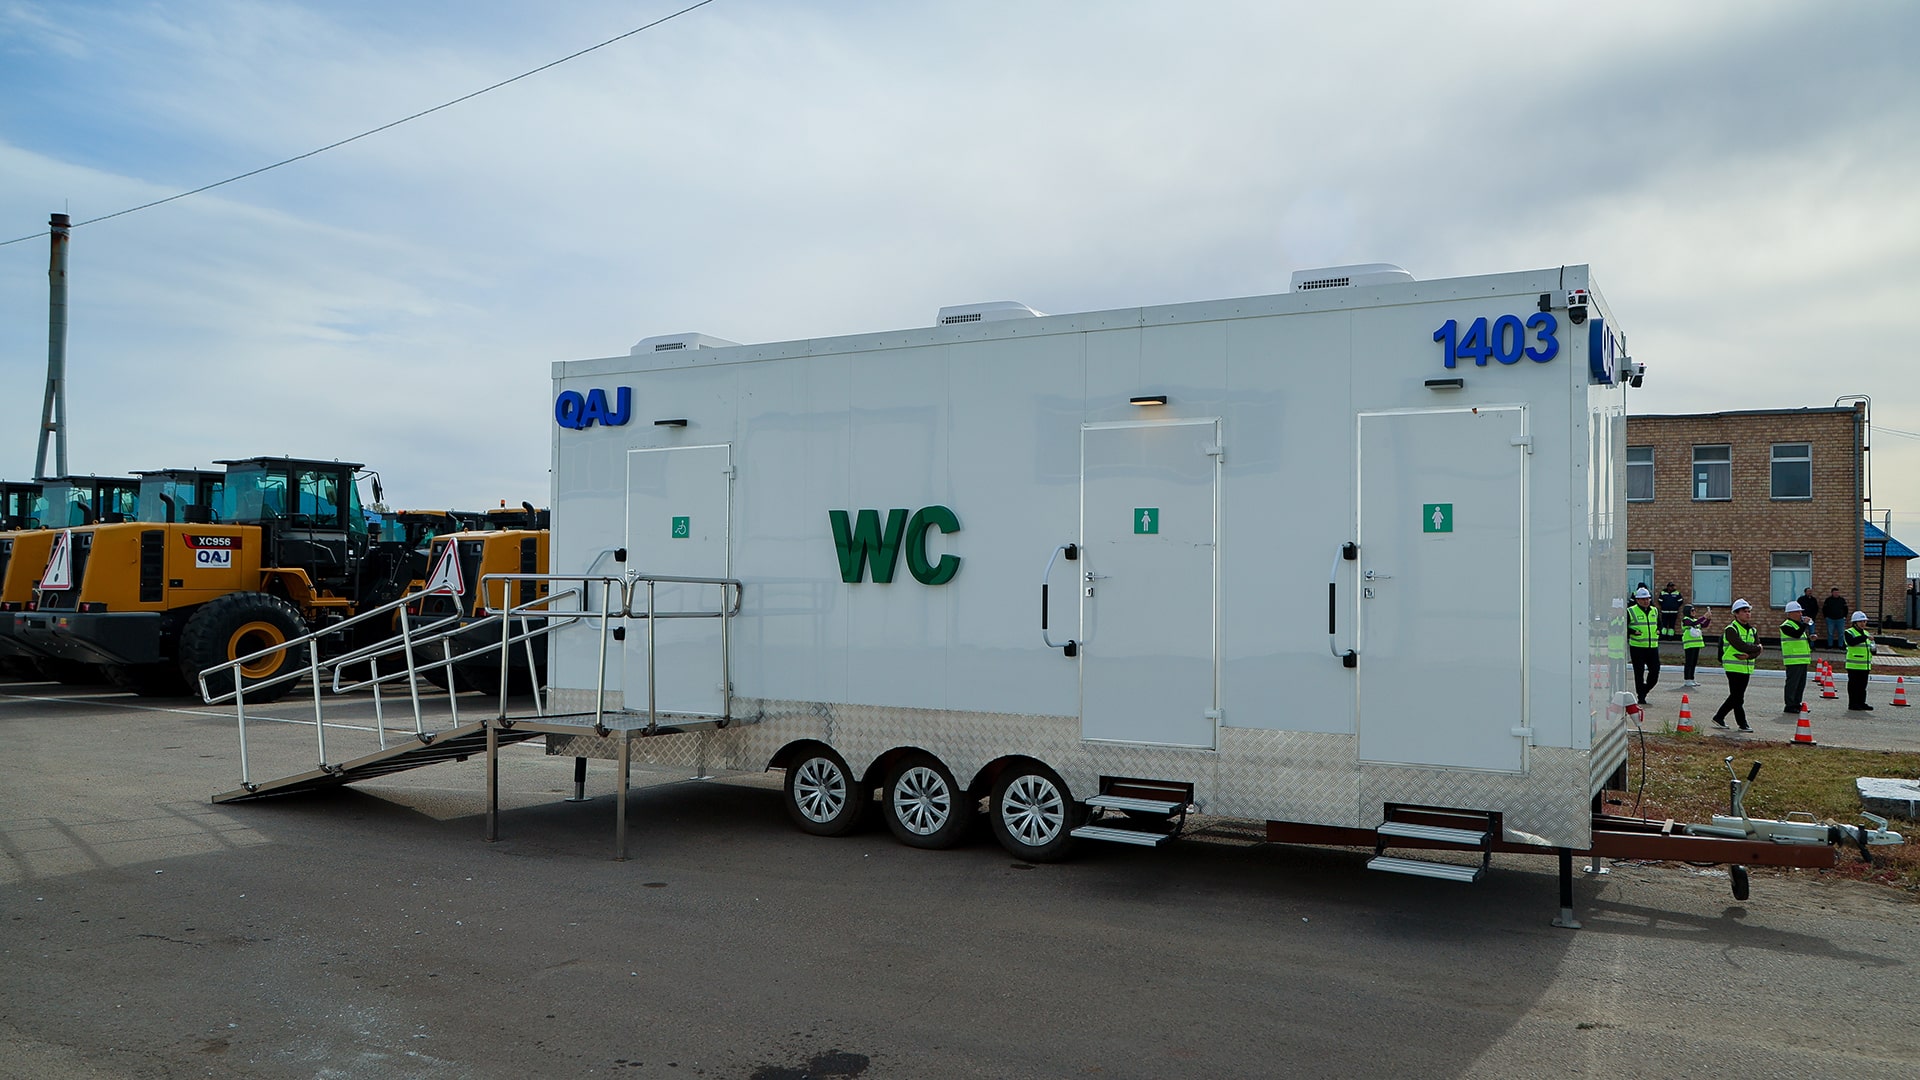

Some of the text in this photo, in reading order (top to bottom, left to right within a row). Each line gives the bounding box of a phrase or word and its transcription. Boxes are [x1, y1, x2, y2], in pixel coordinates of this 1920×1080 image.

[1433, 312, 1559, 368] 1403
[555, 386, 632, 430] QAJ
[197, 550, 230, 564] QAJ
[199, 537, 231, 546] XC956
[828, 505, 961, 585] WC
